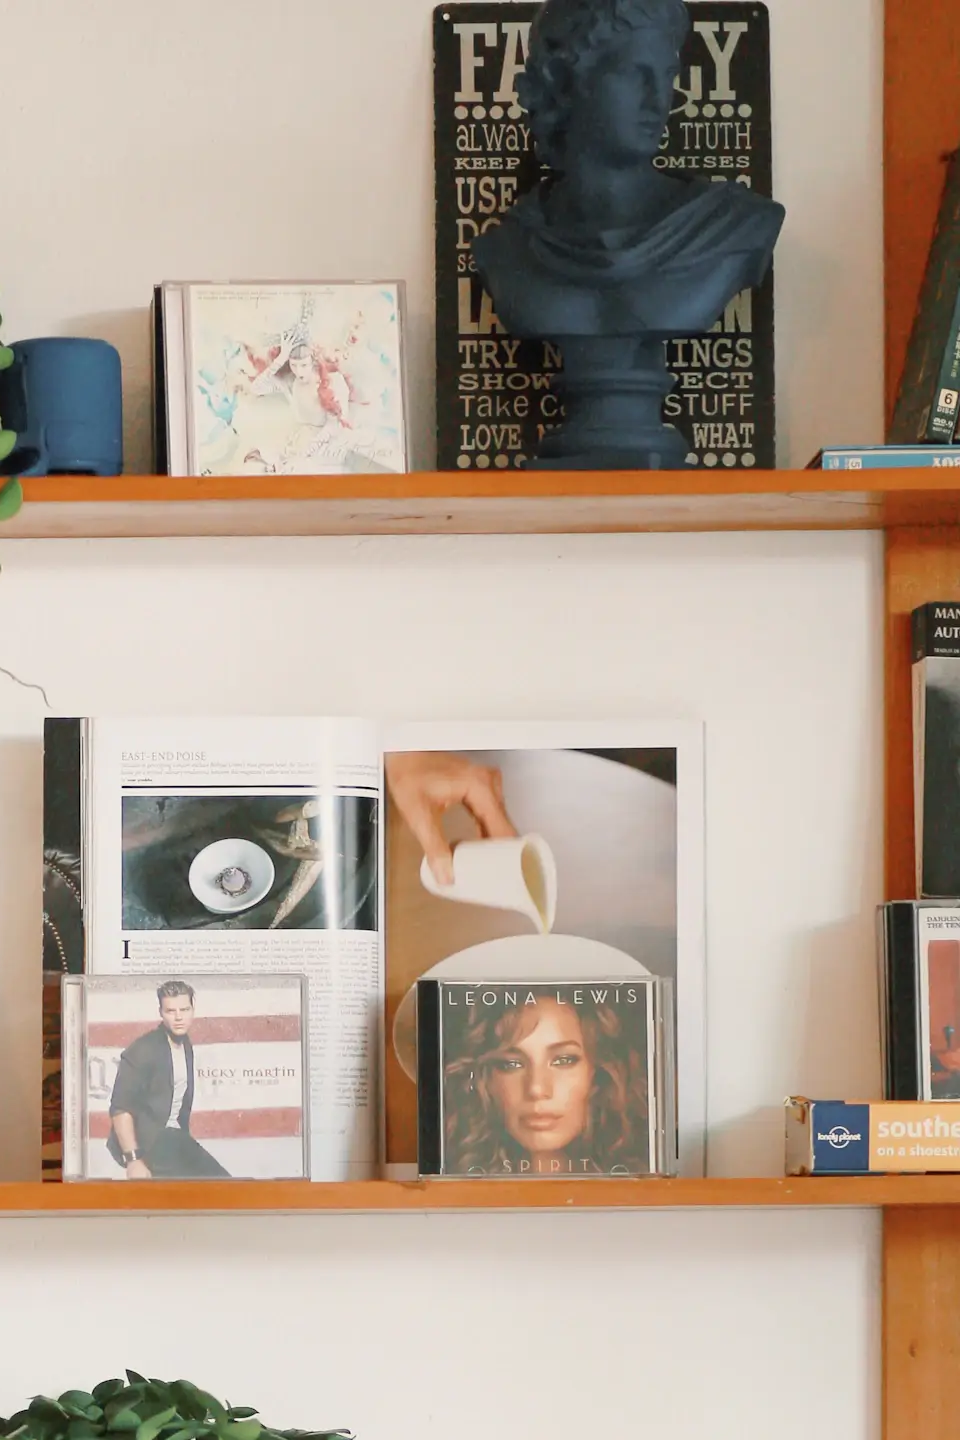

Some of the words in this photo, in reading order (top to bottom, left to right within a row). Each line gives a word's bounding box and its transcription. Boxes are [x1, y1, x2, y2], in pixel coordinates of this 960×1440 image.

[454, 157, 520, 170] KEEP
[652, 156, 750, 169] OMISES
[455, 176, 518, 214] USE
[458, 340, 521, 369] TRY
[663, 338, 753, 368] INGS
[458, 373, 556, 391] SHOW
[664, 393, 754, 417] STUFF
[944, 393, 953, 405] 6
[936, 406, 955, 415] DISC
[460, 424, 522, 451] LOVE
[692, 423, 755, 449] WHAT
[121, 751, 174, 762] EAST-END
[176, 751, 207, 761] POISE
[447, 990, 537, 1006] LEONA
[556, 988, 638, 1005] LEWIS
[817, 1132, 838, 1143] lonely
[839, 1132, 861, 1143] planet
[877, 1145, 894, 1156] on
[898, 1145, 906, 1156] a
[502, 1158, 590, 1173] SPIRIT
